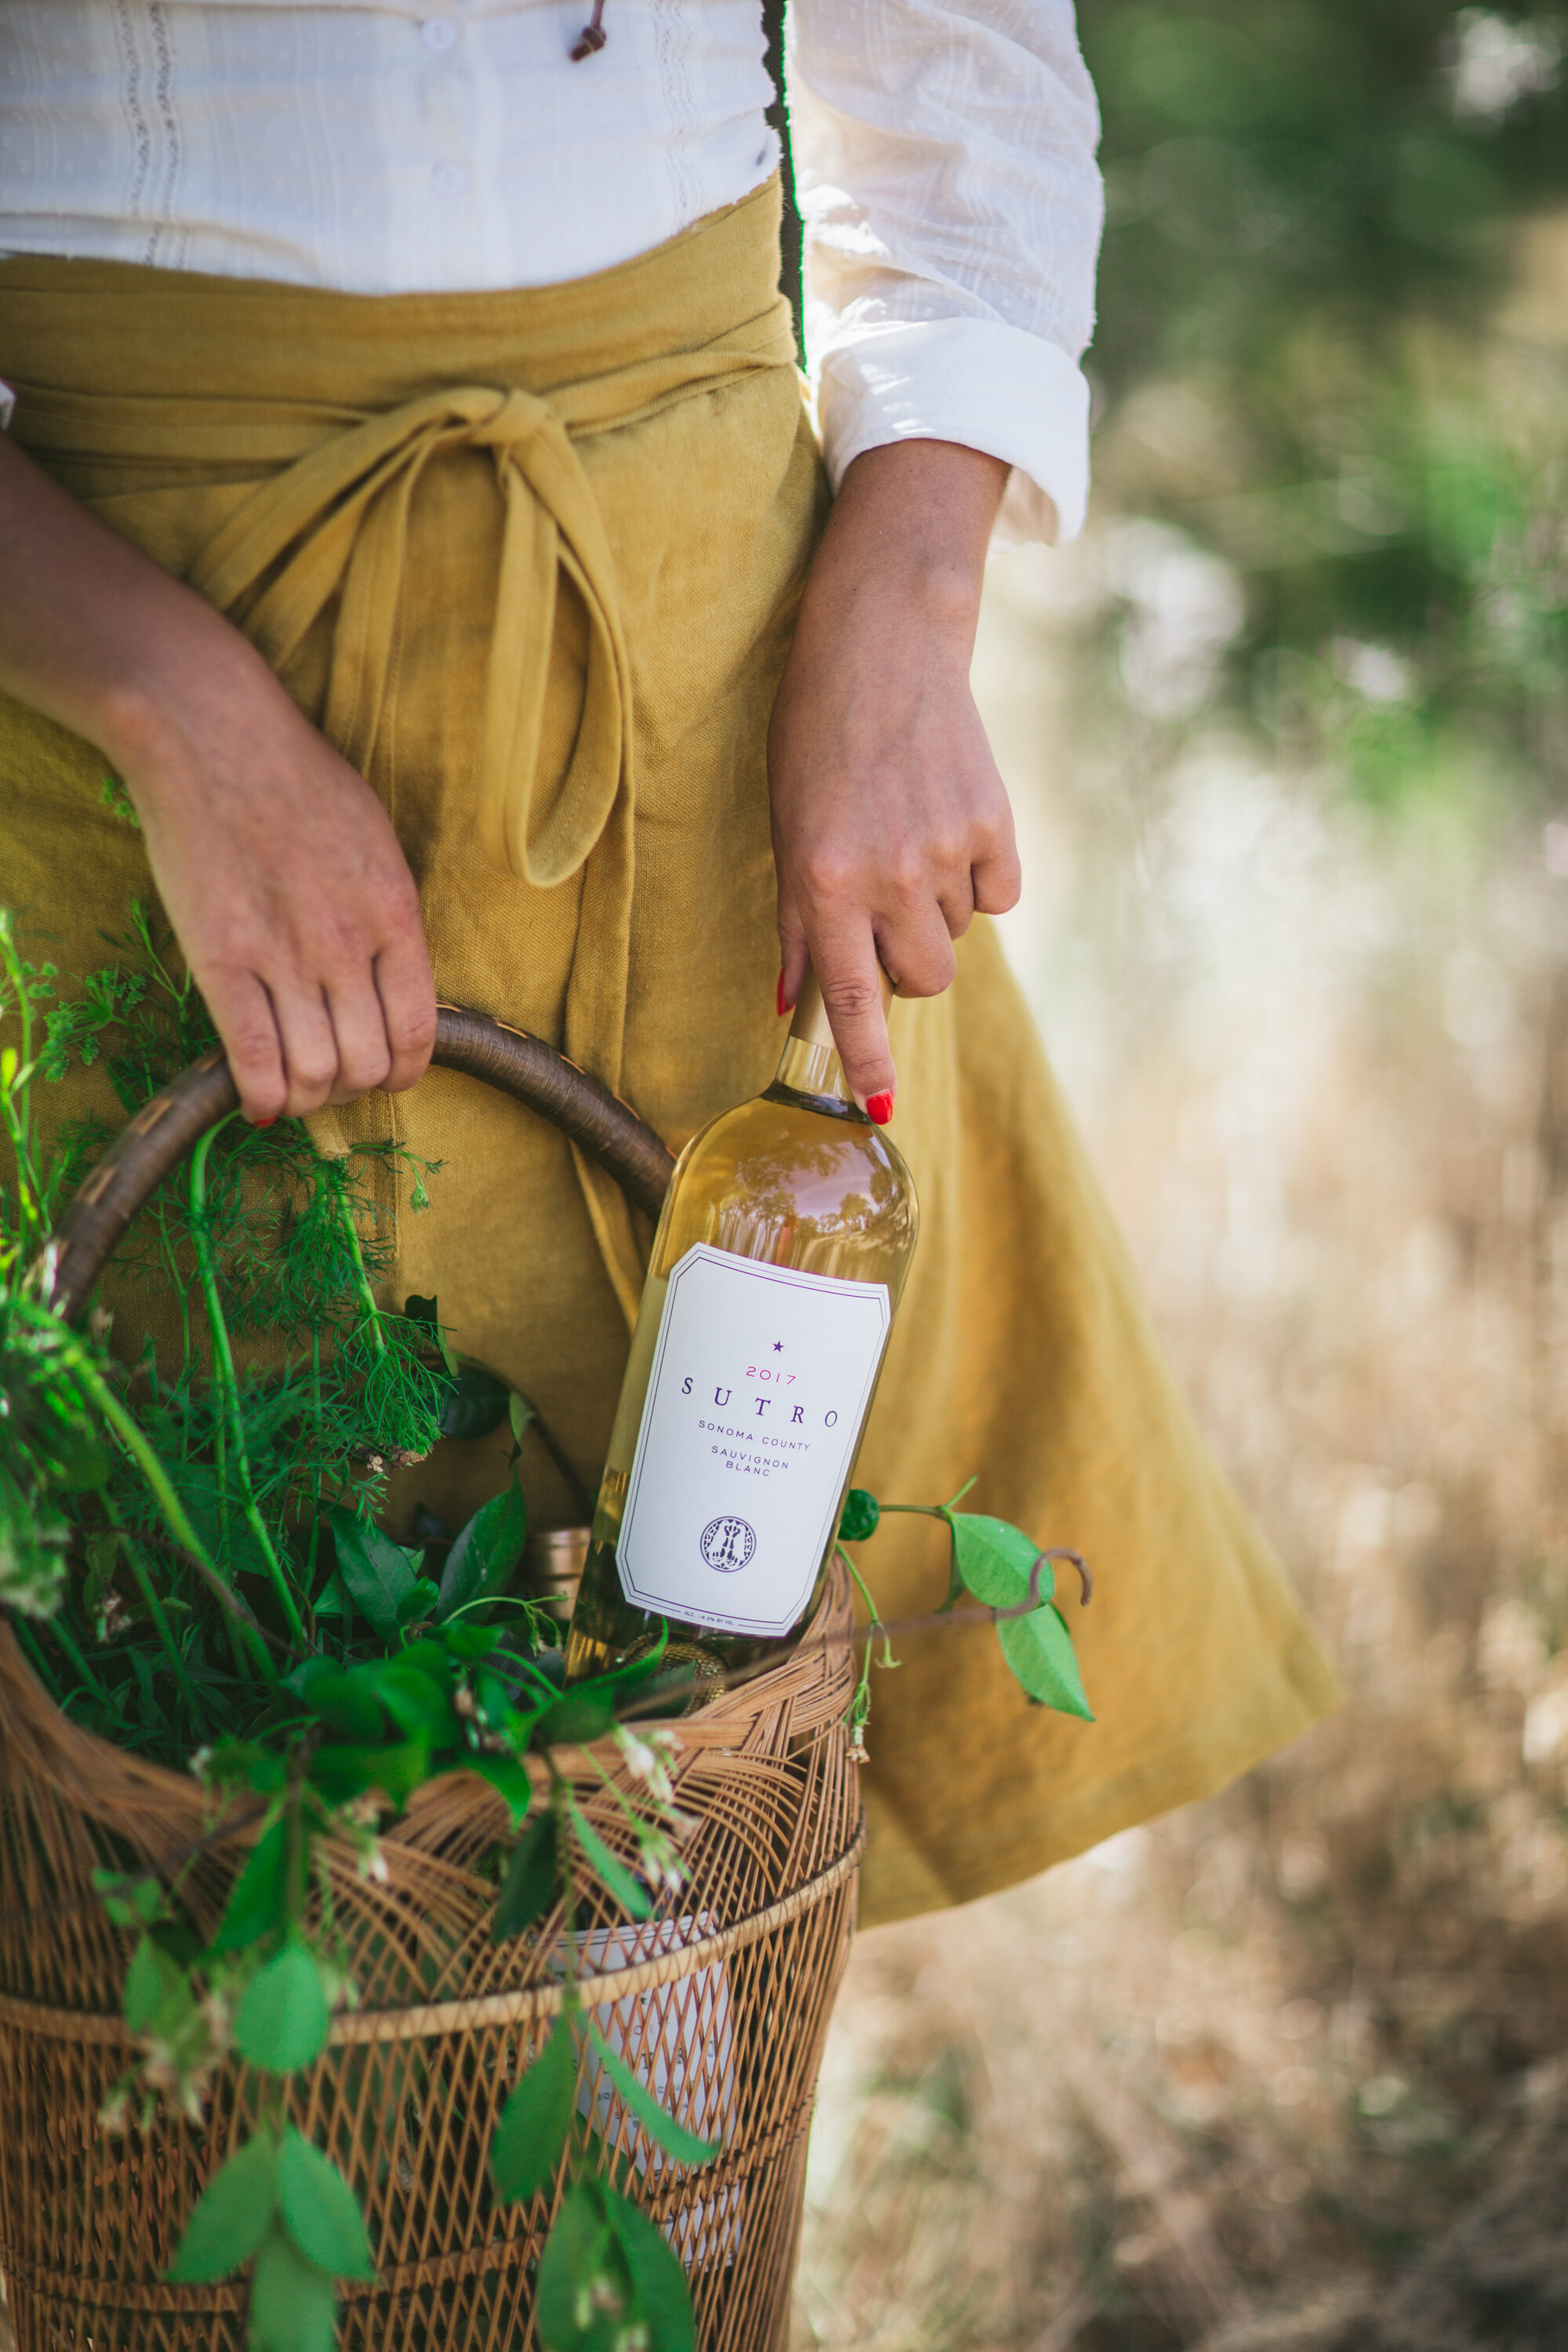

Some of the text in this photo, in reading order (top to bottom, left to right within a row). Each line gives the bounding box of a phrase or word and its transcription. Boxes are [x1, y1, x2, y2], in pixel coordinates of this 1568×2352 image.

[746, 1366, 797, 1385] 2017
[681, 1377, 838, 1428] SUTRO
[698, 1420, 811, 1451] SONOMA COUNTY
[711, 1445, 789, 1469] SAUVIGNON
[726, 1460, 771, 1477] BLANC
